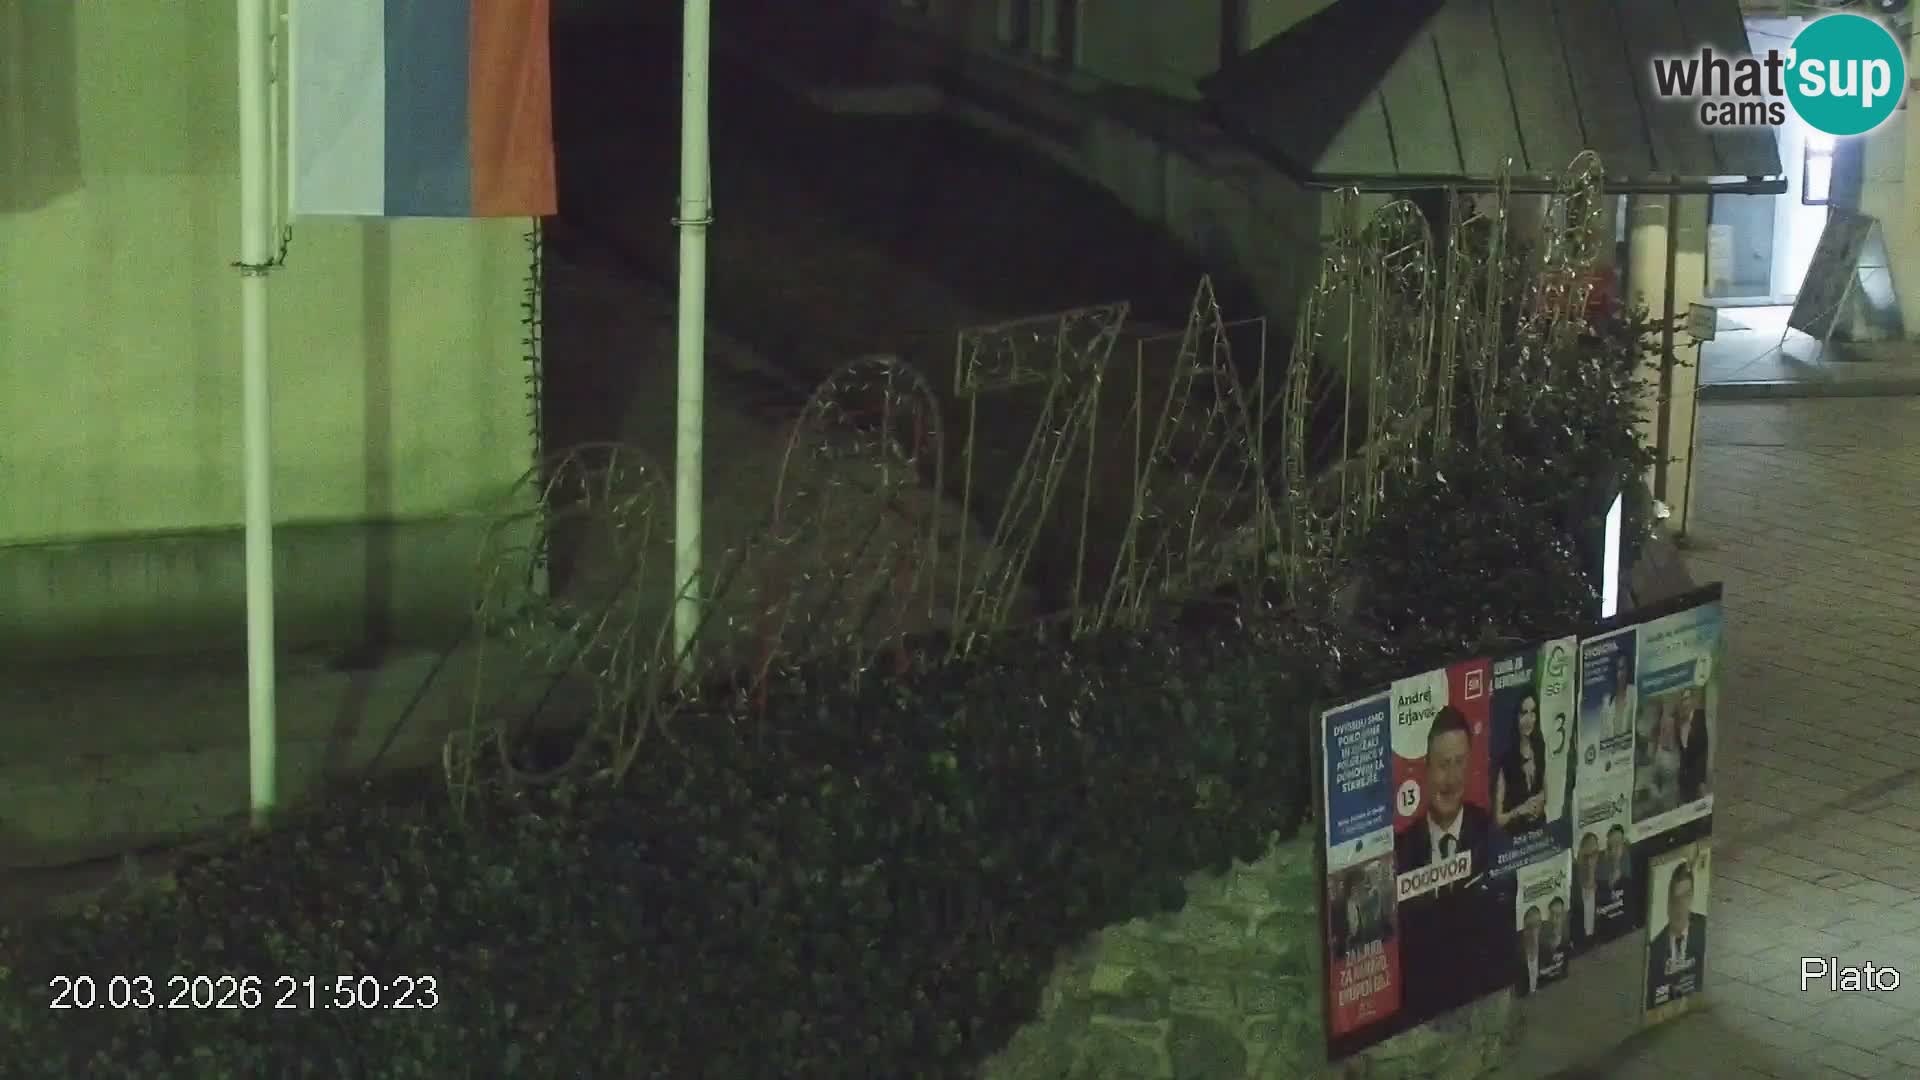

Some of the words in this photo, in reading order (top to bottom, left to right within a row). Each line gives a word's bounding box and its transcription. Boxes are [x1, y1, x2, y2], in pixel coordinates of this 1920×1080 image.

[1398, 685, 1432, 705] Andrej
[1553, 711, 1566, 755] 3
[1401, 788, 1416, 807] 13
